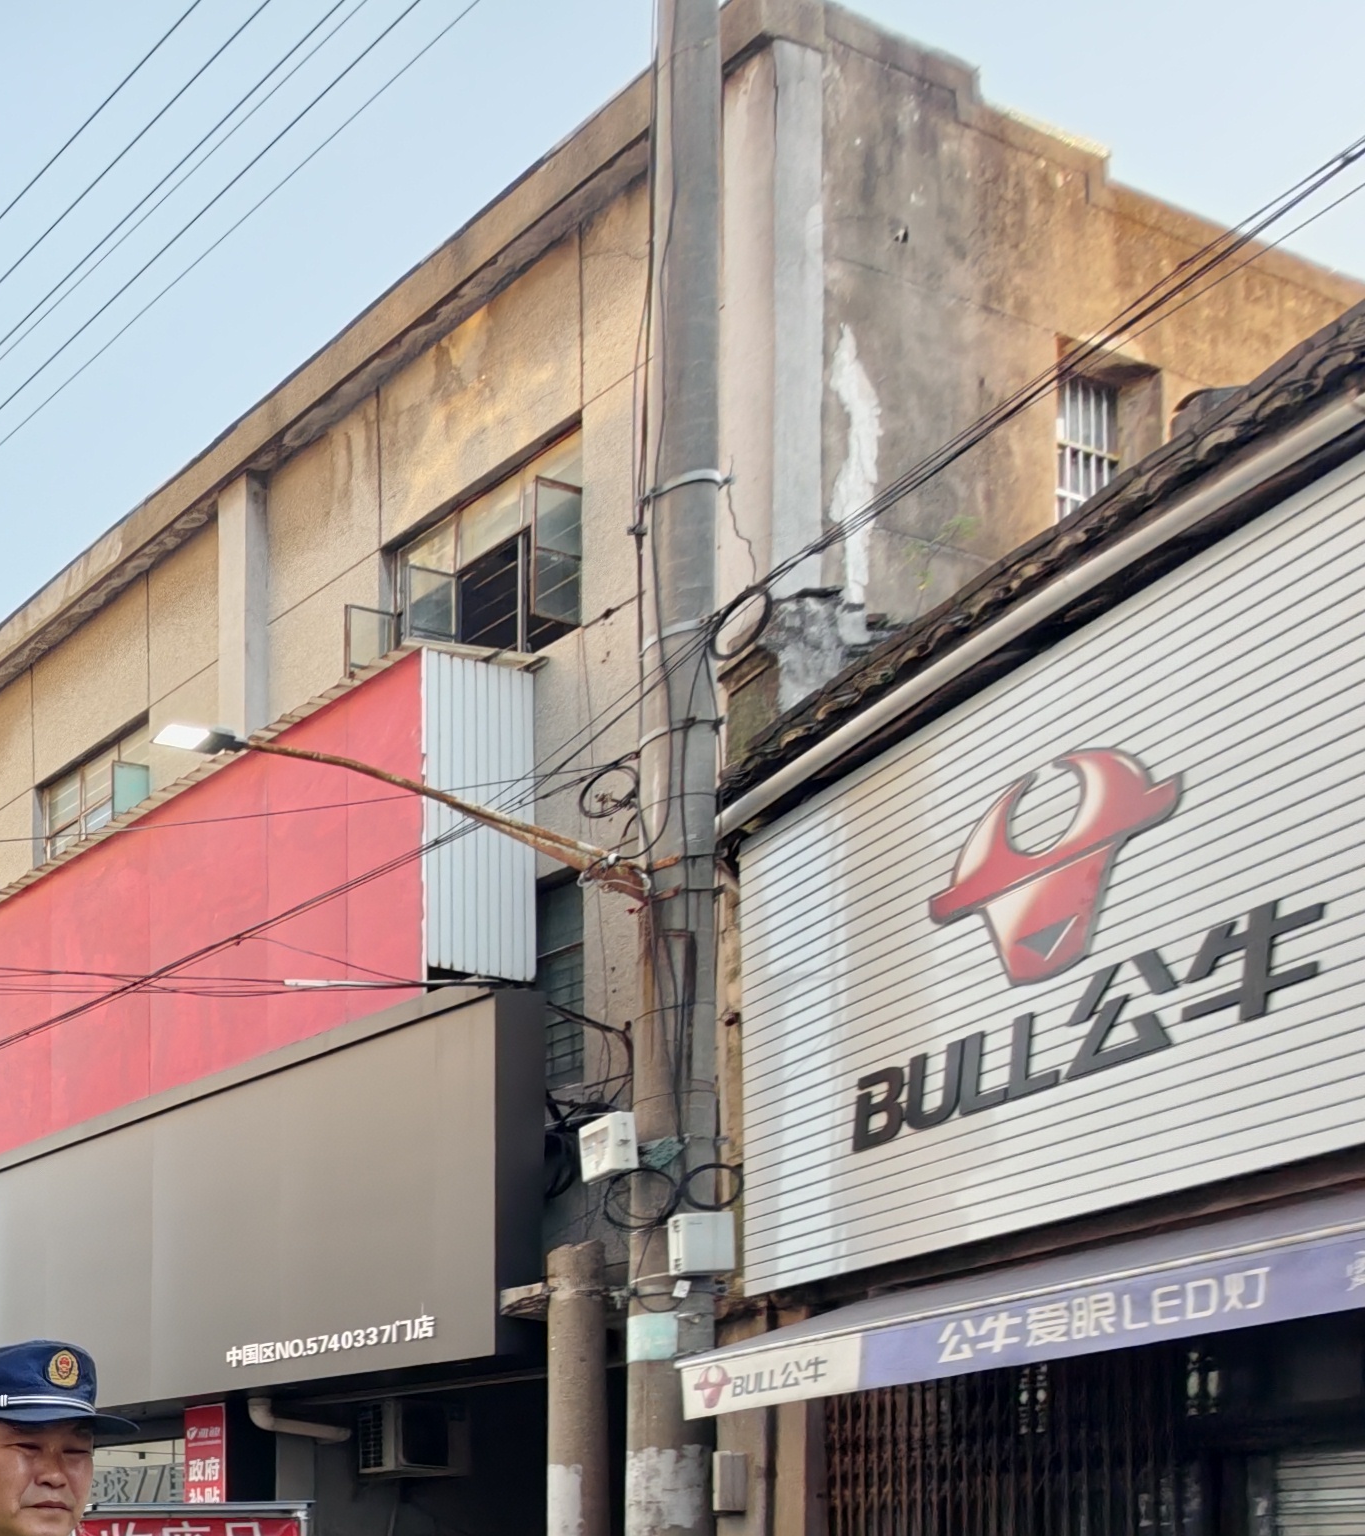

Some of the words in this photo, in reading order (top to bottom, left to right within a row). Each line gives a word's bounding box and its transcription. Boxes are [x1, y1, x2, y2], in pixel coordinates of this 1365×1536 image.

[852, 899, 1327, 1152] BULL公牛
[226, 1314, 435, 1367] 中国区NO.5740337门店
[938, 1266, 1271, 1364] 公牛爱眼LED灯
[731, 1357, 828, 1398] BULL公牛
[188, 1458, 220, 1481] 政府
